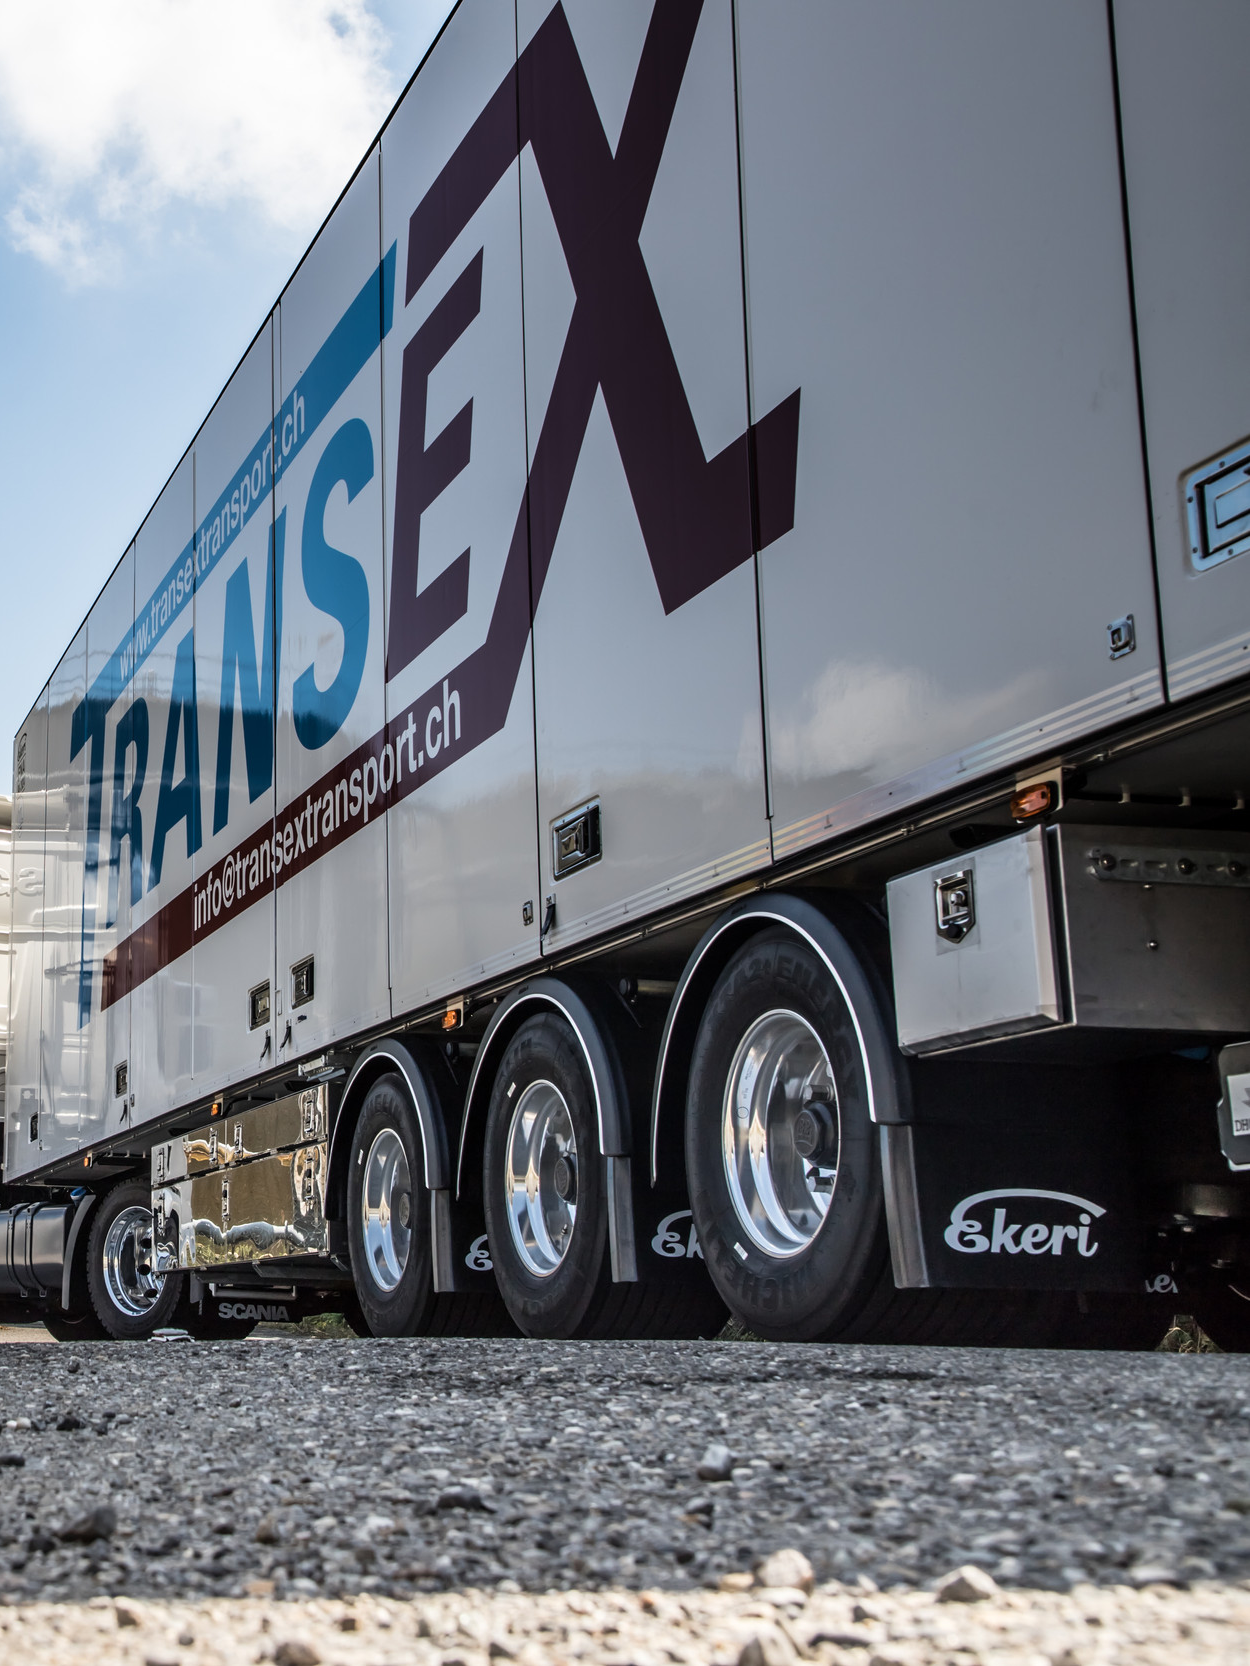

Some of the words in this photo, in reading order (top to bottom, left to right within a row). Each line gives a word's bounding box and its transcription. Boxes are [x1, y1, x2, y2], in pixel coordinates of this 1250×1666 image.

[119, 389, 306, 682] www.transextransport.ch
[193, 679, 461, 932] info@transextransport.ch
[944, 1188, 1107, 1258] Ekeri
[218, 1302, 290, 1321] SCANIA
